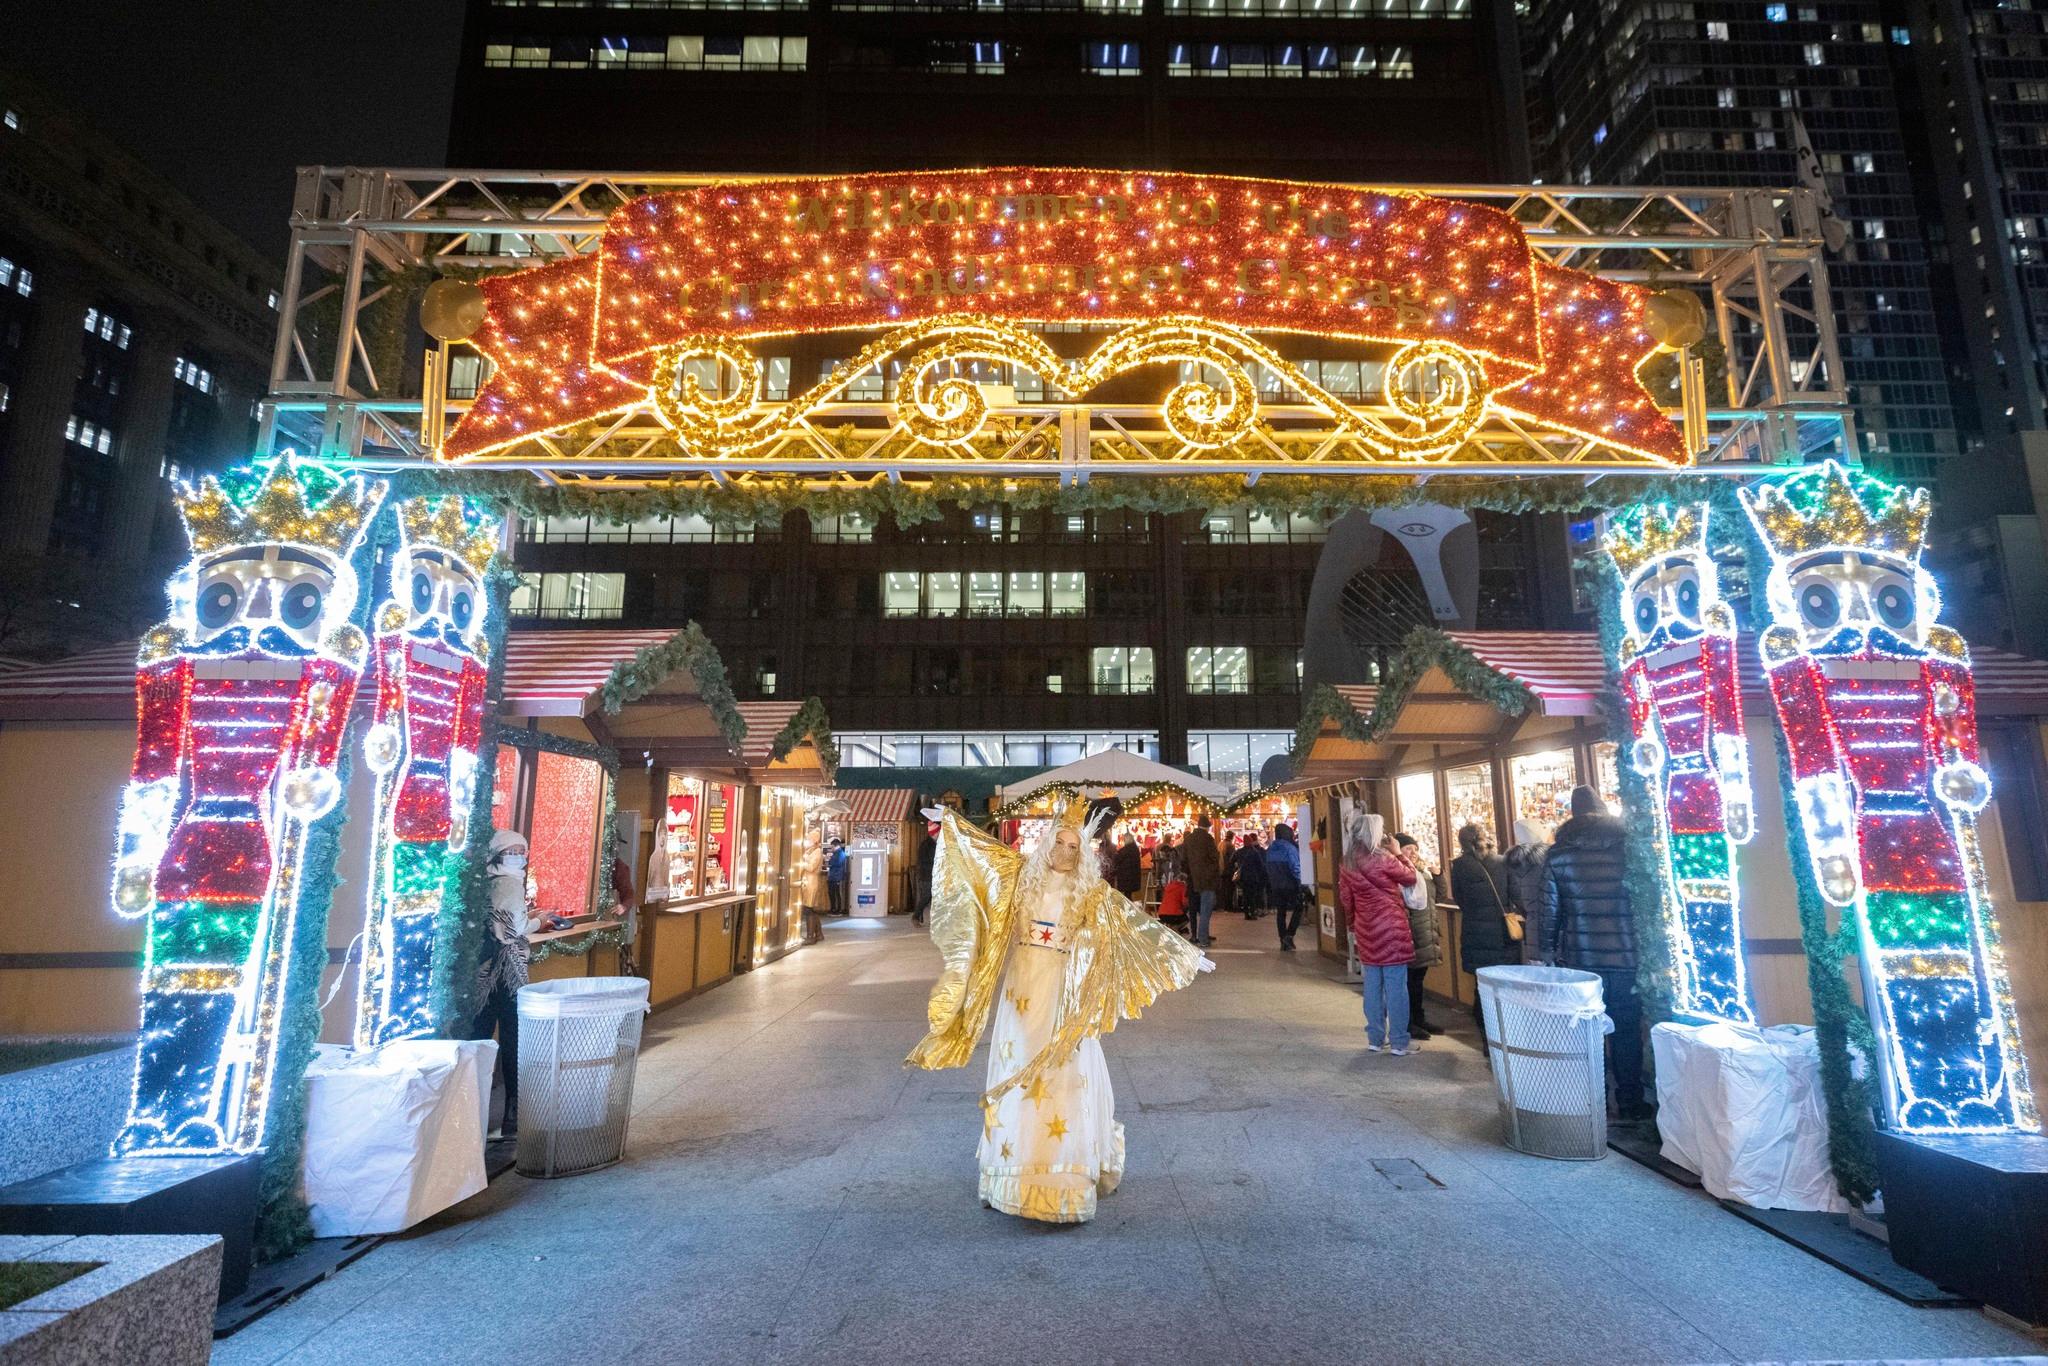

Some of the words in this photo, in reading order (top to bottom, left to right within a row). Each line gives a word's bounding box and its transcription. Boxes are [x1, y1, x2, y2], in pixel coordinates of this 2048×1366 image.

[786, 187, 1128, 232] Willkommen
[1169, 195, 1220, 226] to
[1263, 193, 1349, 239] the
[1238, 257, 1457, 325] Chicago
[859, 841, 879, 849] ATM
